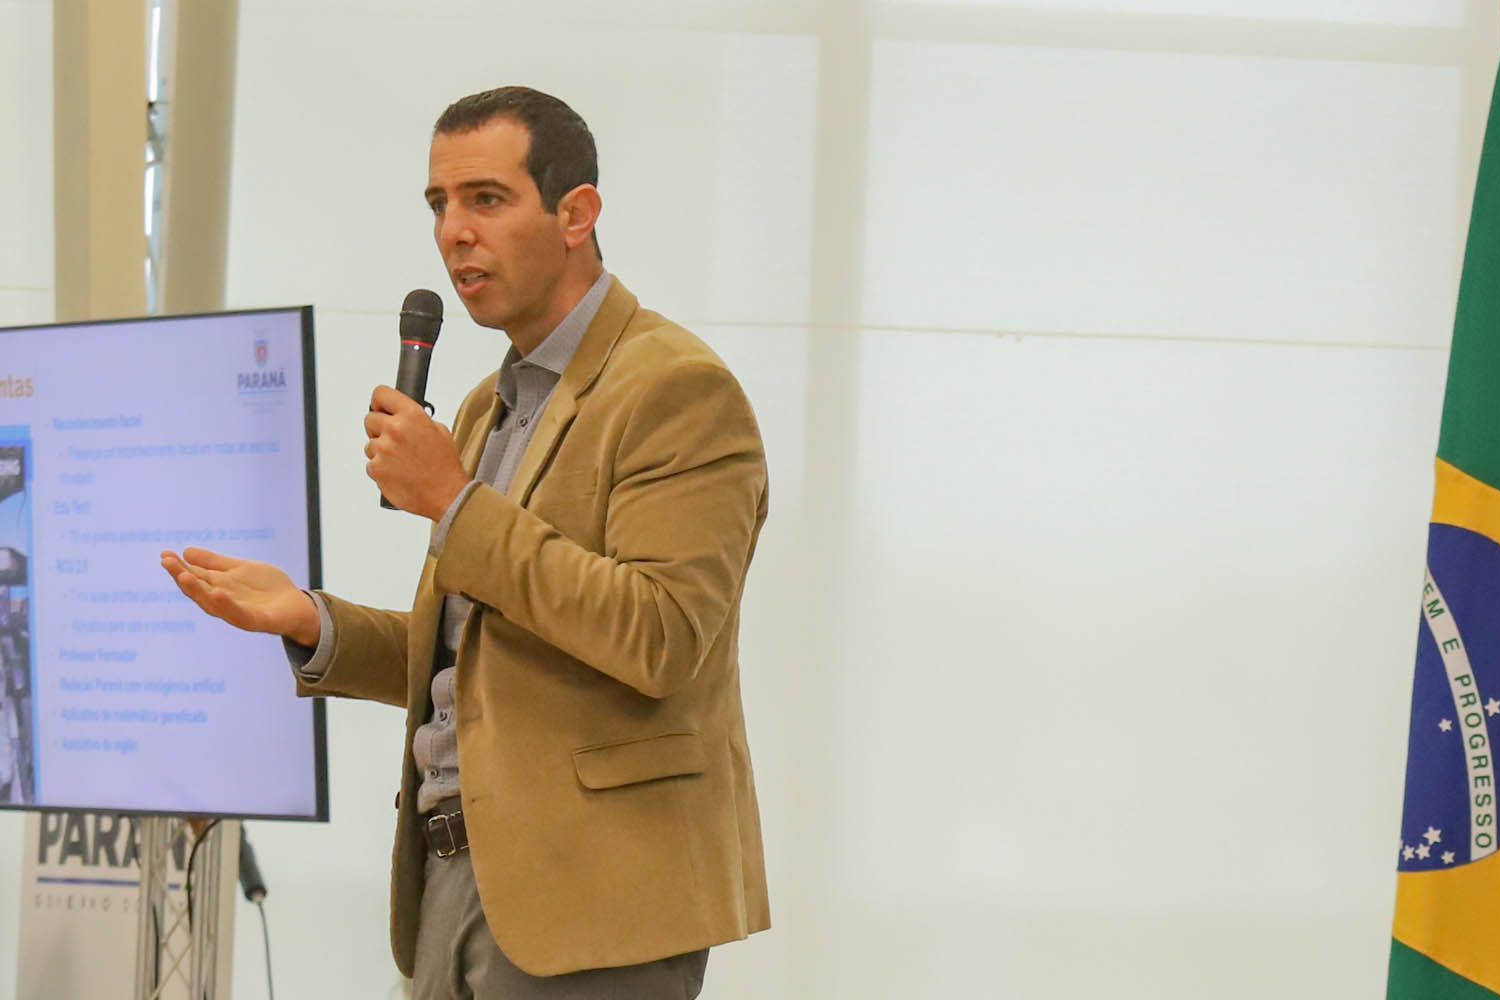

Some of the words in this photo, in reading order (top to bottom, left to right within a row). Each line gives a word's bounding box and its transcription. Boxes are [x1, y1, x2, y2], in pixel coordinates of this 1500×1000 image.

[1424, 568, 1446, 619] EM
[1442, 638, 1460, 655] E
[1454, 674, 1493, 849] PROGRESSO
[37, 811, 188, 871] PARAN
